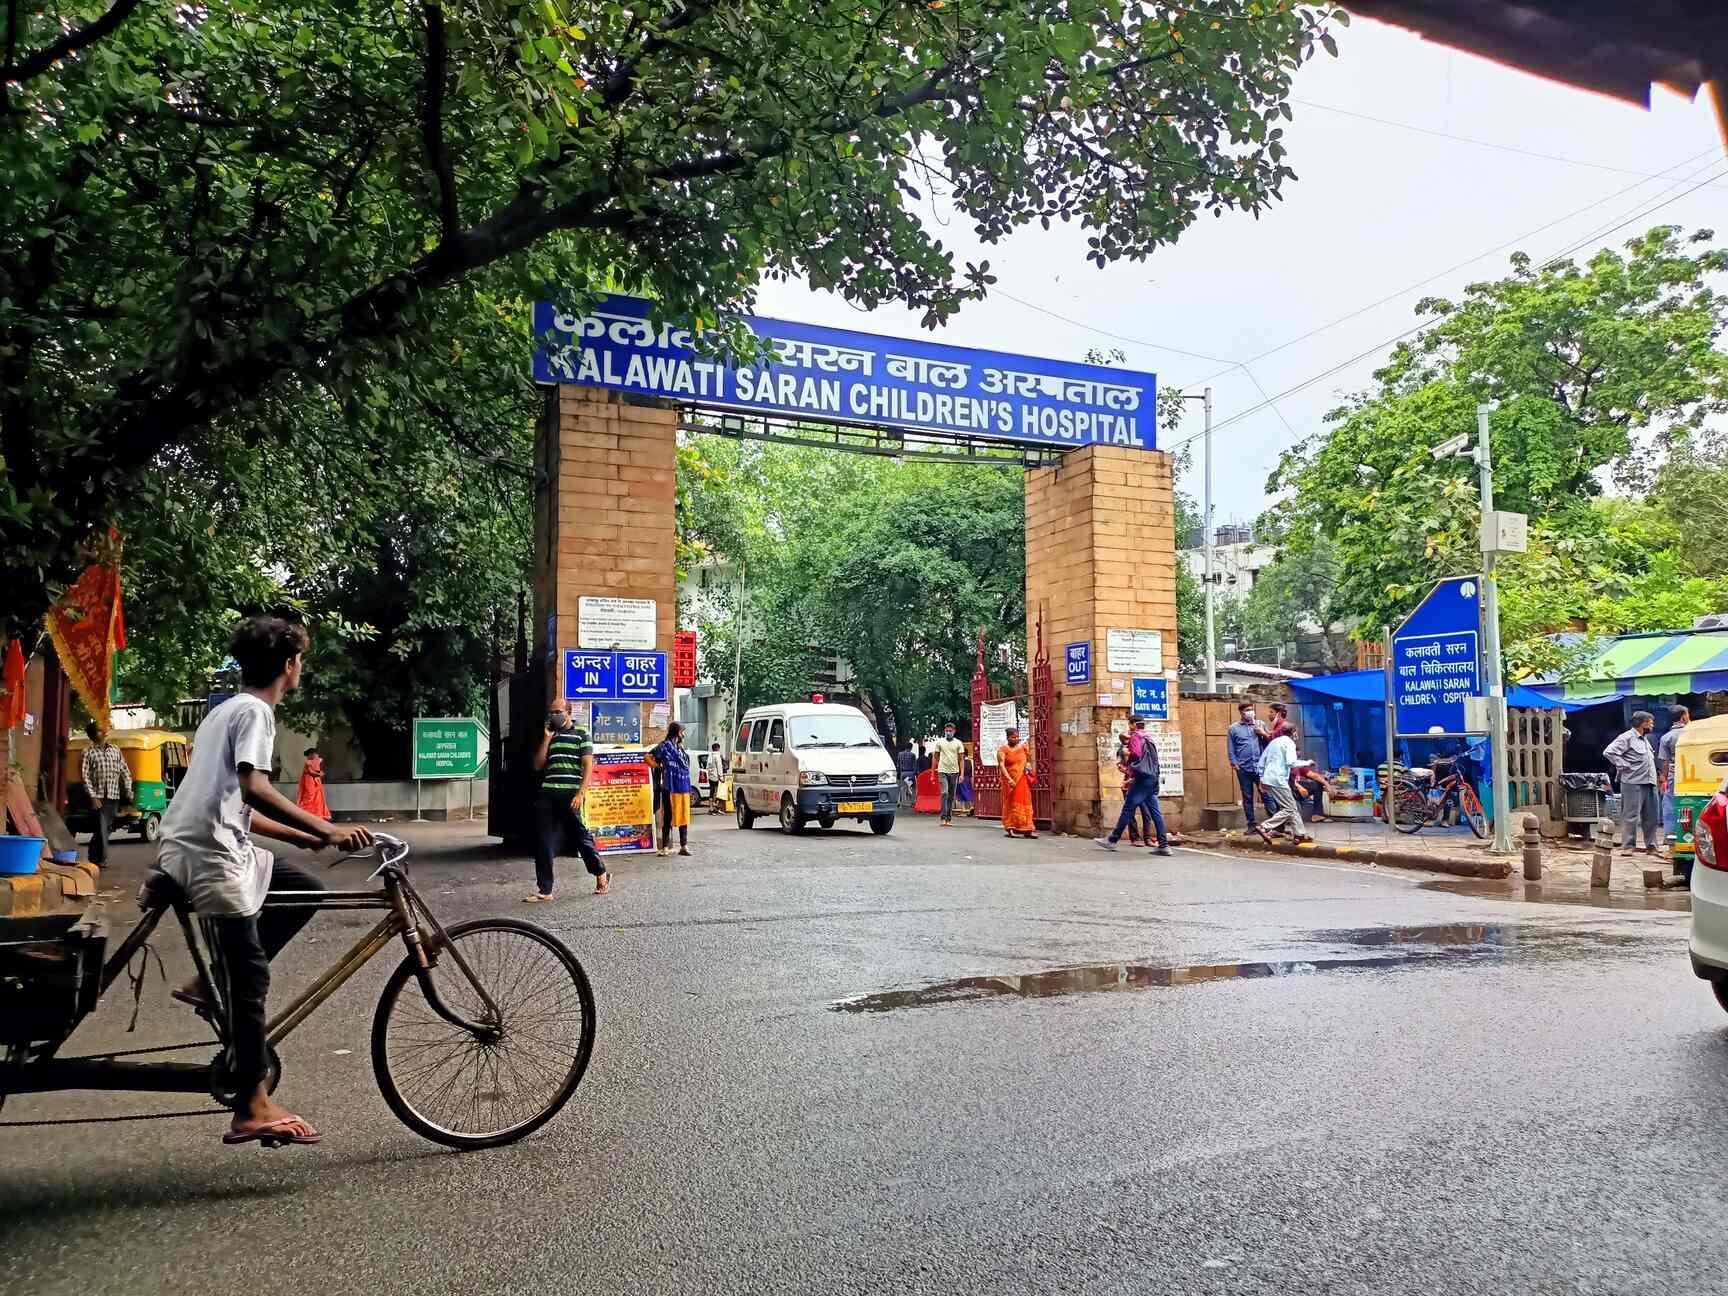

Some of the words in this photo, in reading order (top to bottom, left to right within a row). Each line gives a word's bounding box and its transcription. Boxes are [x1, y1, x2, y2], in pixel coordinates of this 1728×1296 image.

[552, 306, 748, 358] कलाव
[771, 338, 876, 377] सरन
[885, 353, 972, 390] बाल
[978, 368, 1144, 411] अस्पताल
[549, 345, 724, 398] KALAWATI
[735, 367, 841, 412] SARAN
[850, 382, 1014, 432] CHILDREN'S
[1022, 404, 1144, 446] HOSPITAL
[1405, 642, 1440, 658] कलावती
[1445, 643, 1467, 655] सरन
[571, 656, 612, 670] अन्दर
[623, 656, 657, 672] बाहर
[1068, 661, 1087, 674] OUT
[1399, 665, 1417, 677] बाल
[1421, 660, 1475, 677] चिकित्सालय
[584, 672, 599, 686] IN
[621, 673, 660, 687] OUT
[1405, 679, 1442, 692] KALAWATI
[1443, 677, 1470, 690] SARAN
[1443, 691, 1473, 704] OSPITA
[594, 732, 616, 742] GATE
[634, 732, 639, 742] 5
